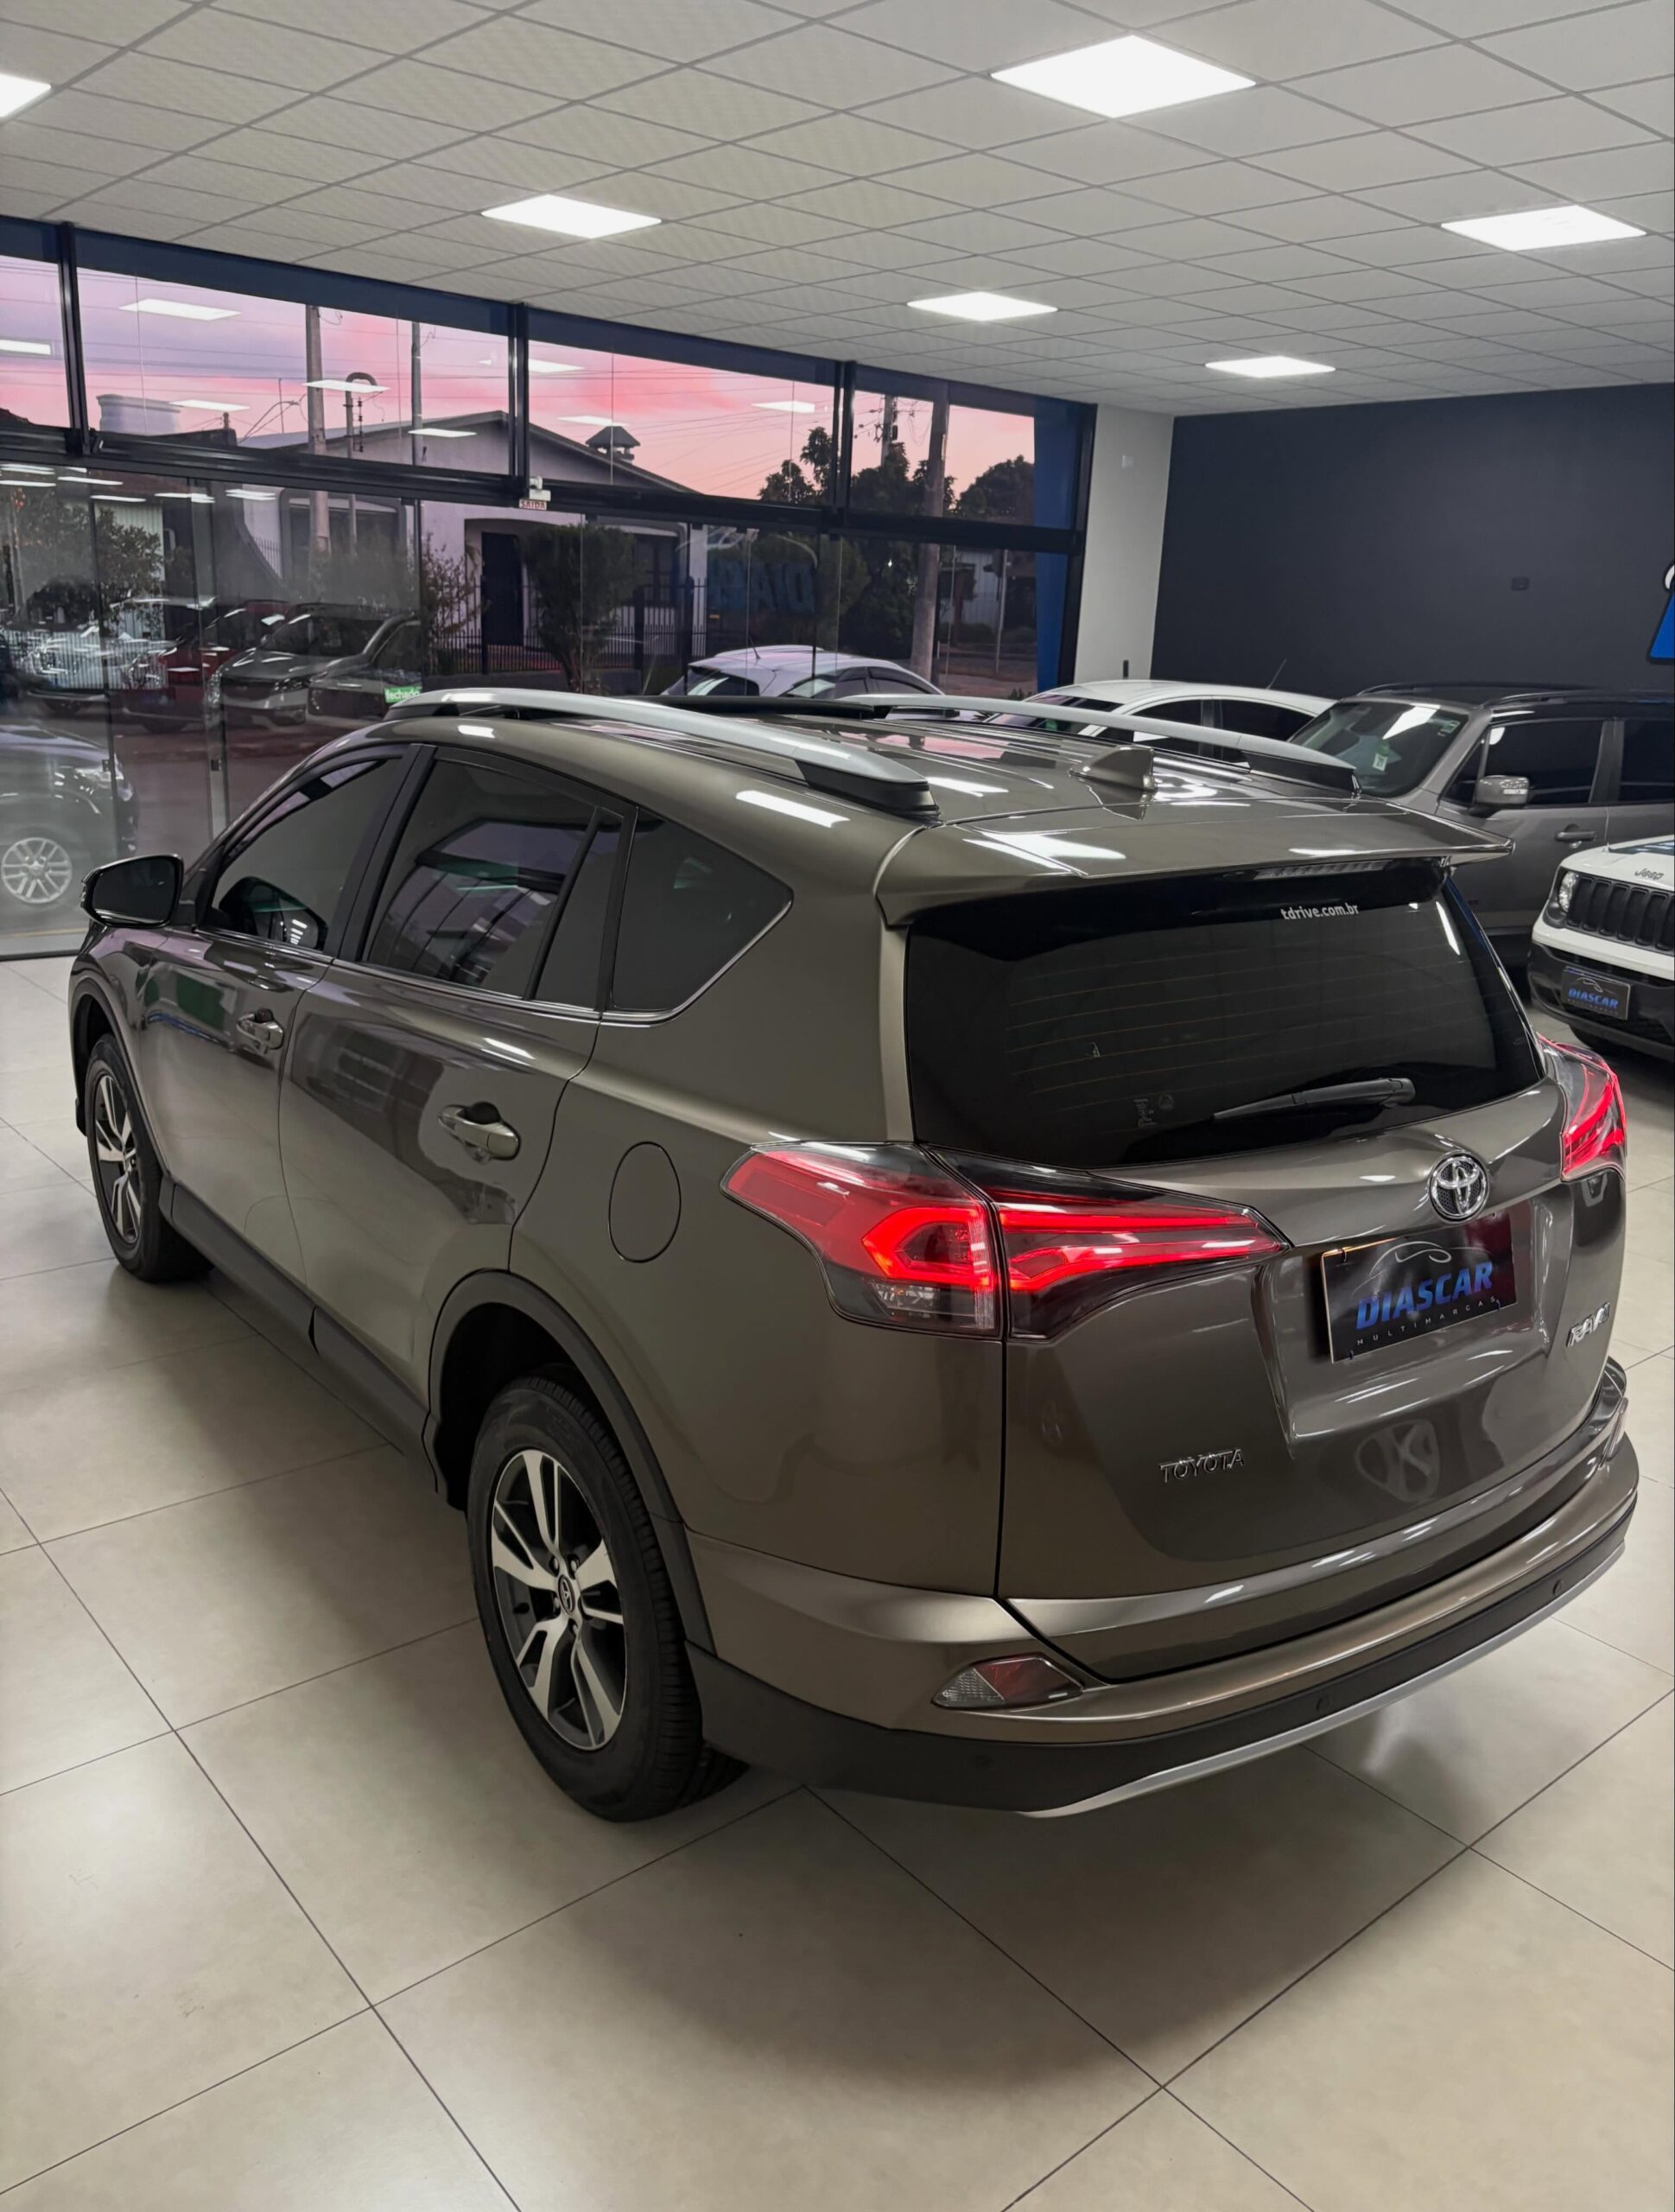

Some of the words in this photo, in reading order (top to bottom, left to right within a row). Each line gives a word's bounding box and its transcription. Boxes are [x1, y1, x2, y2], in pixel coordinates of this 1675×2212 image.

[1634, 868, 1665, 880] Jeep
[1280, 901, 1359, 920] tdrive.com.br
[1568, 987, 1619, 1009] DIASCAR
[1356, 1261, 1494, 1330] DIASCAR
[1357, 1295, 1495, 1346] MULTIMARCAS
[1159, 1448, 1244, 1484] TOYOTA
